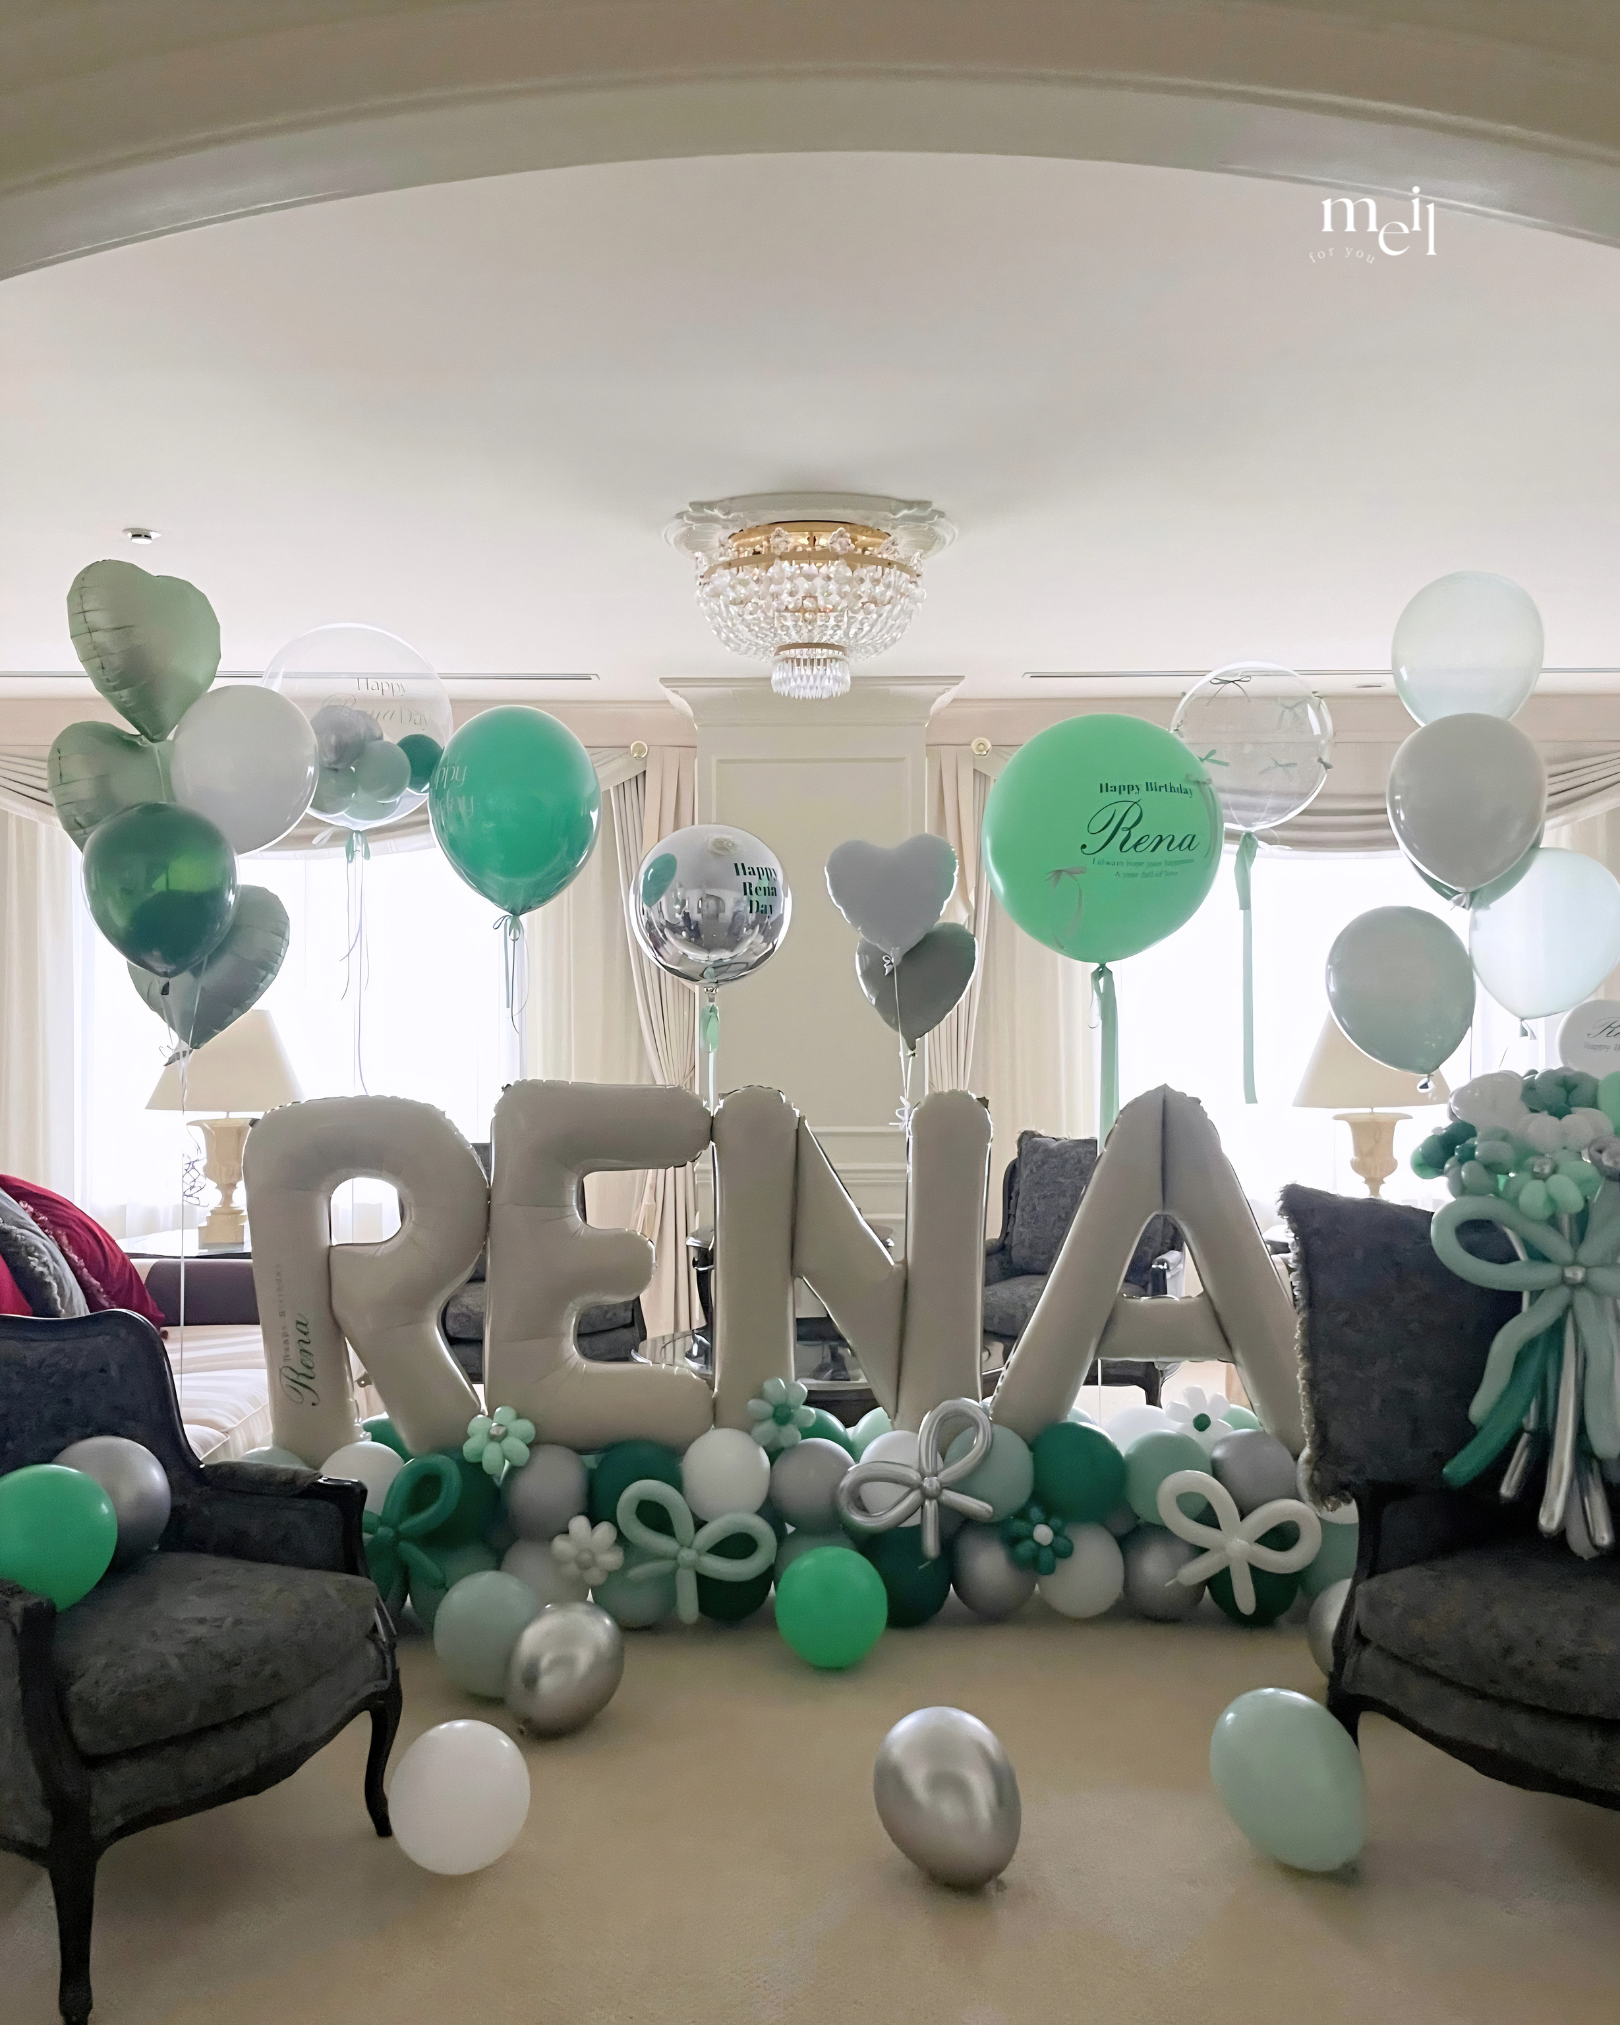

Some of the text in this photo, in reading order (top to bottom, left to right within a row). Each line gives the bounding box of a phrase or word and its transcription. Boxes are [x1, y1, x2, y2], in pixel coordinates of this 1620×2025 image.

[357, 678, 406, 697] Happy
[1099, 781, 1193, 798] Happy Birthday
[1080, 798, 1200, 855] Rena
[734, 863, 777, 881] Happy
[743, 882, 777, 897] Rena
[749, 900, 773, 919] Day
[242, 1079, 1305, 1464] RENA
[279, 1313, 320, 1406] Rena
